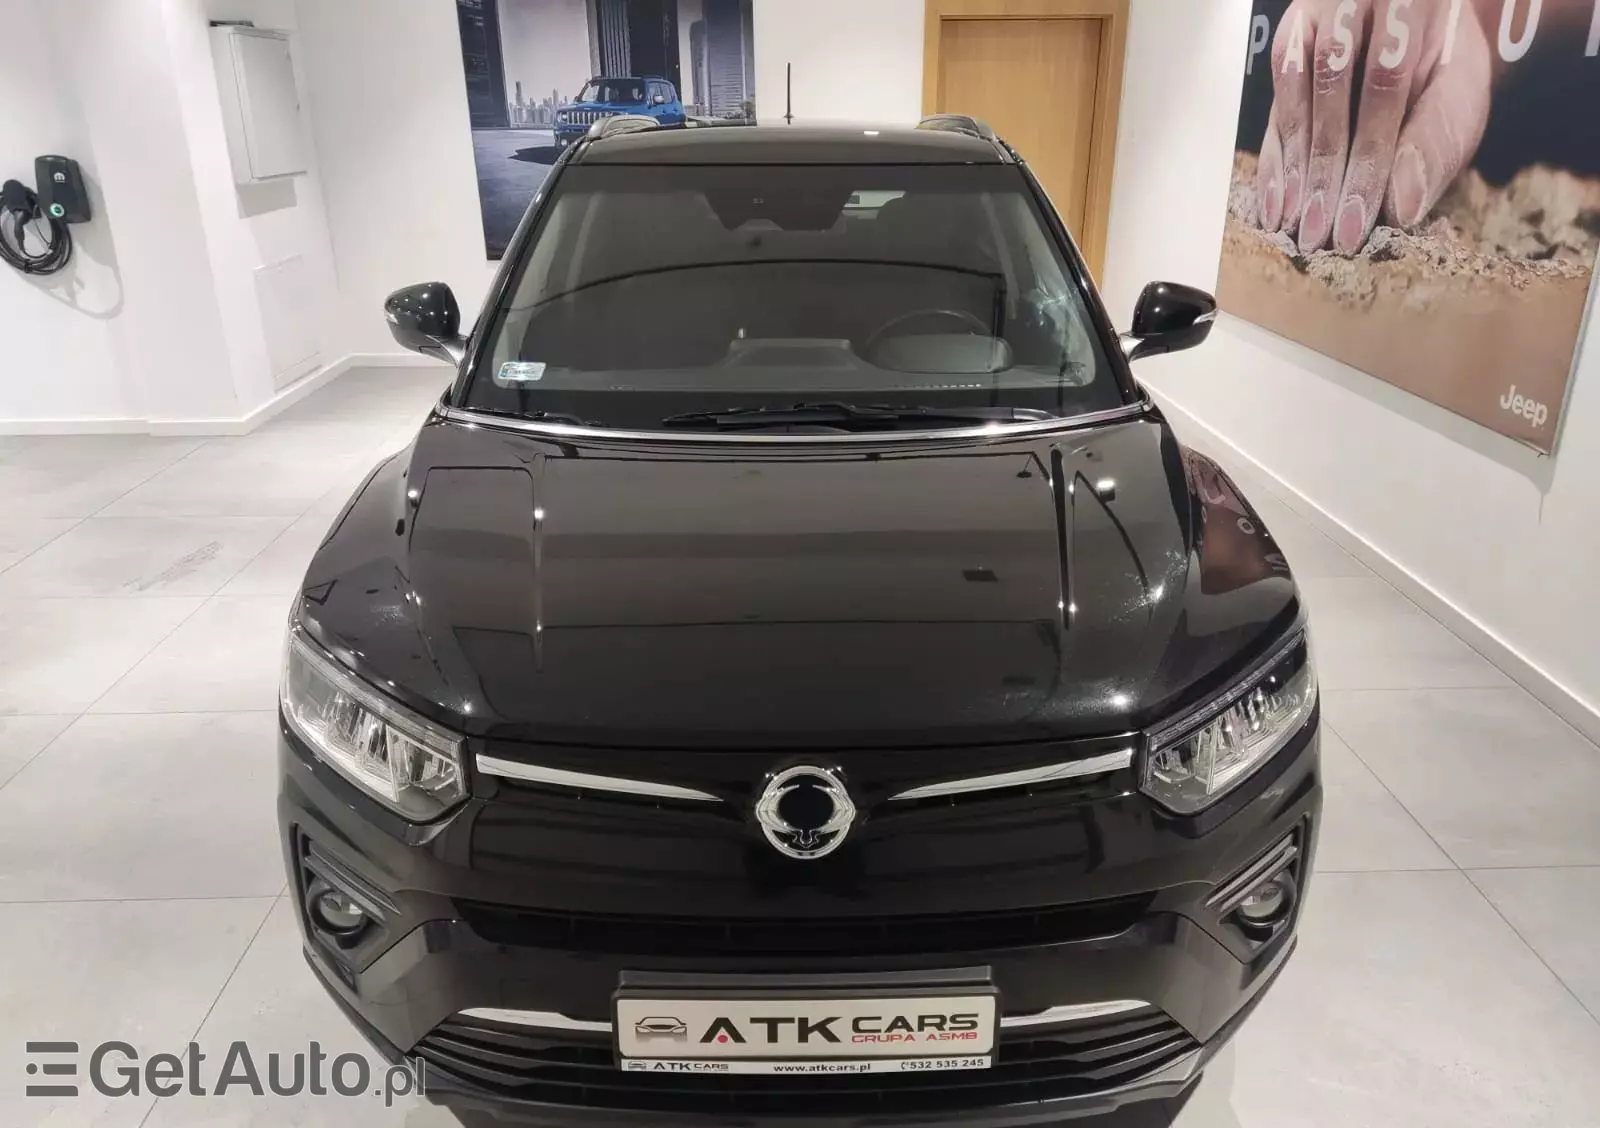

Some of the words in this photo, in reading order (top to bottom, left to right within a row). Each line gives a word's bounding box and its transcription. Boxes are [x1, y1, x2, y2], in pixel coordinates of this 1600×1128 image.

[1500, 384, 1548, 428] Jeep
[699, 1016, 842, 1043] ATK
[852, 1013, 979, 1034] CARS
[851, 1034, 916, 1043] GRUPA
[653, 1062, 692, 1071] ATK
[773, 1063, 871, 1073] www.atkcars.pl
[911, 1060, 932, 1069] 532
[937, 1059, 958, 1068] 535
[963, 1058, 984, 1067] 245
